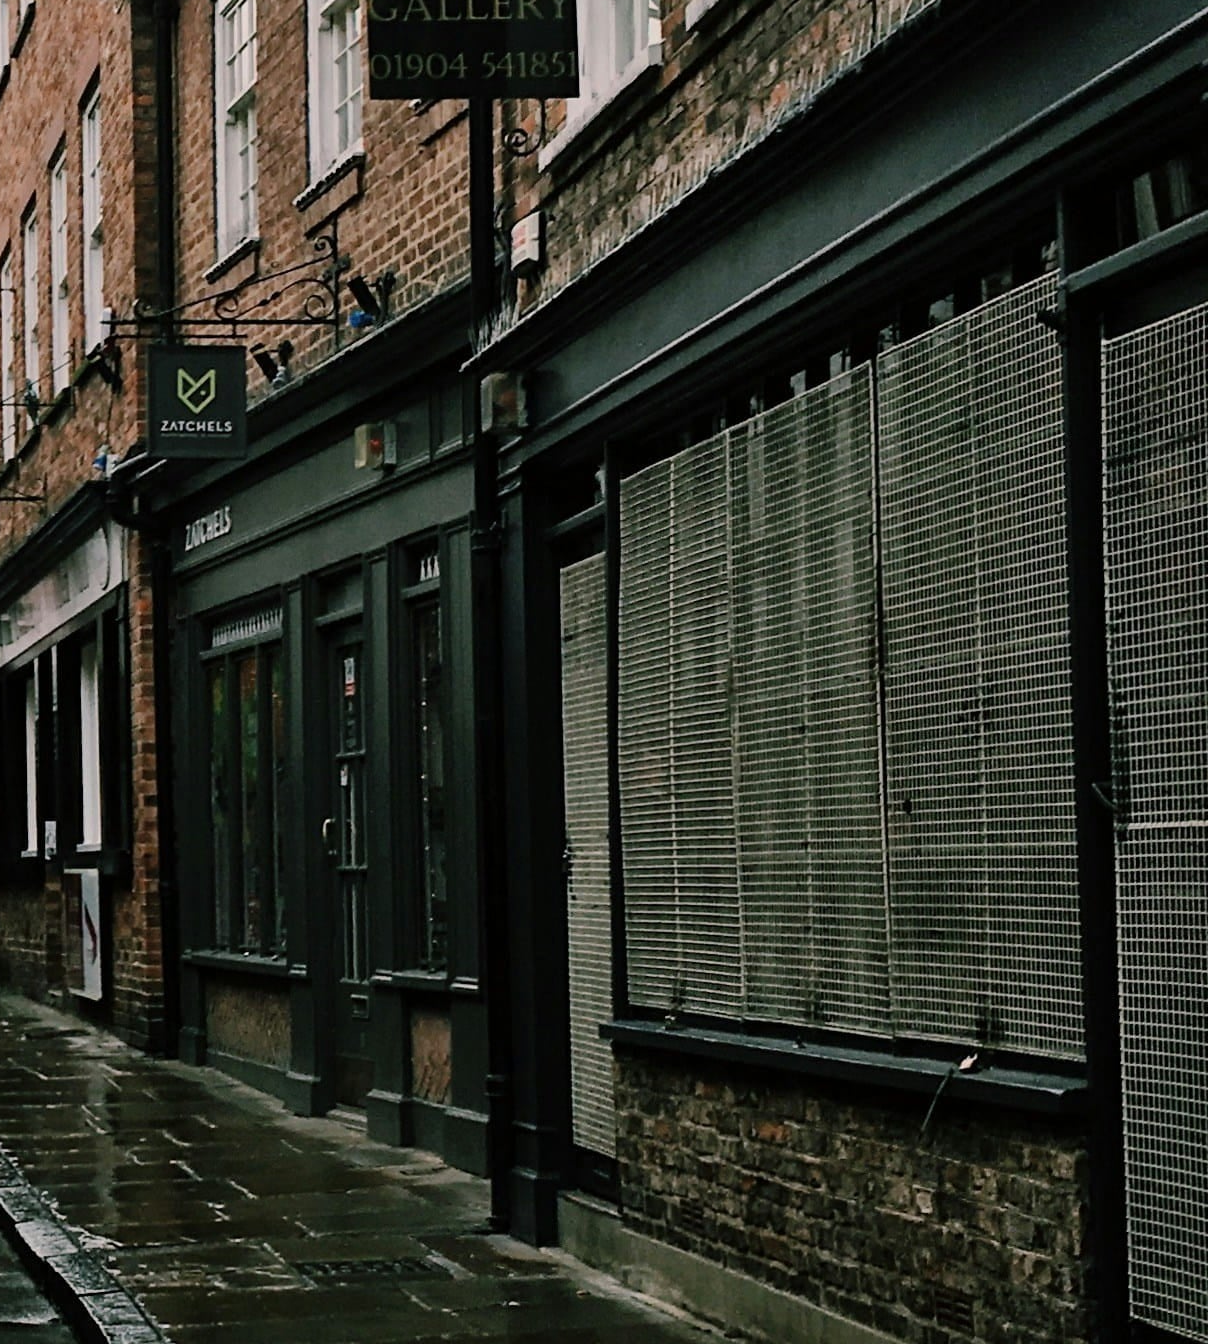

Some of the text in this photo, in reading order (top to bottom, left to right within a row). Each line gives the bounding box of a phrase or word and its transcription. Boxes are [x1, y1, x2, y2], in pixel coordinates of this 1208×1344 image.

[370, 51, 577, 81] 01904 541851
[160, 420, 233, 432] ZATCHELS
[184, 506, 232, 552] ZATCHELS
